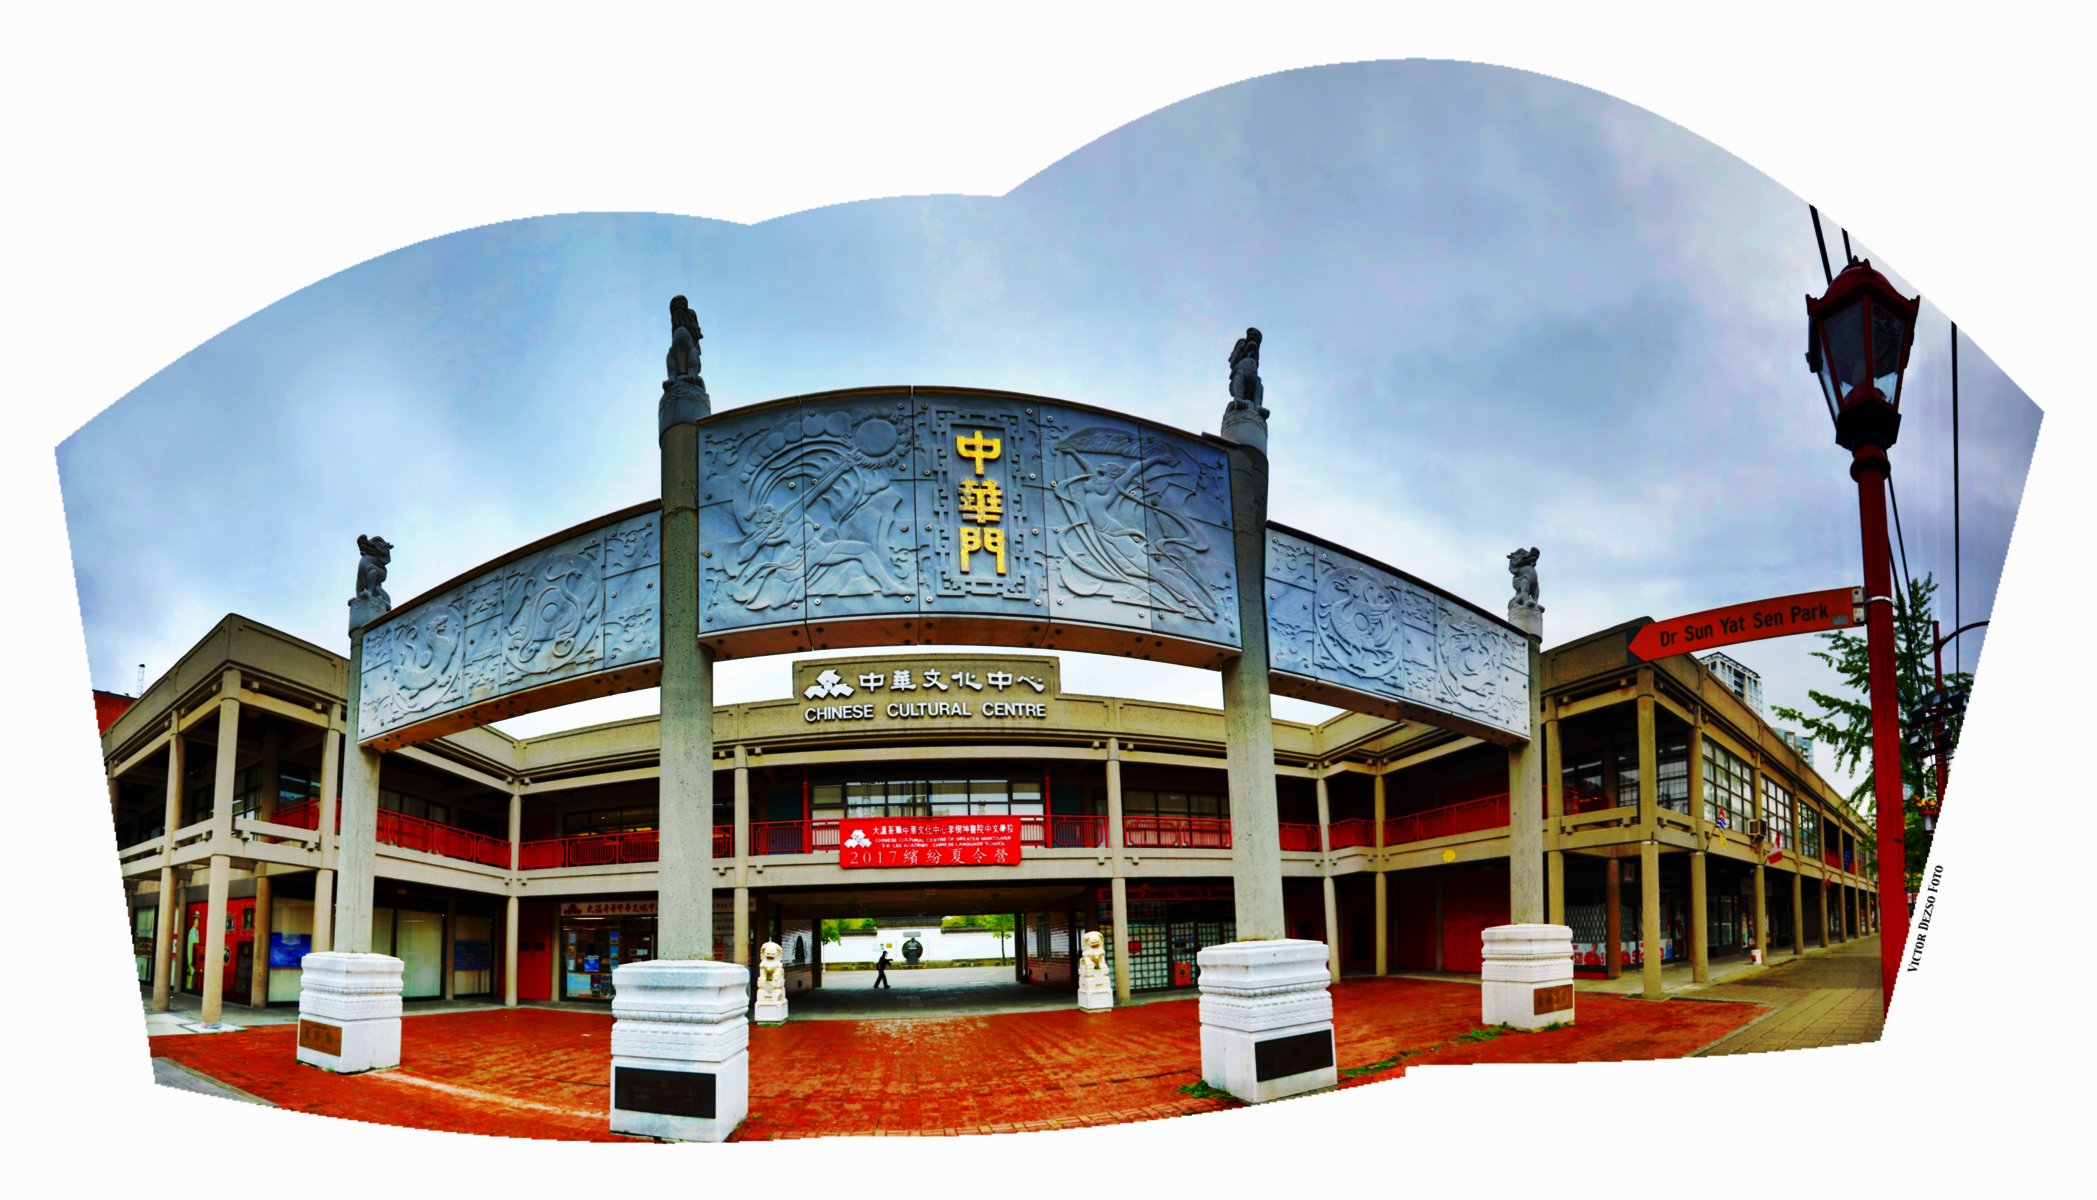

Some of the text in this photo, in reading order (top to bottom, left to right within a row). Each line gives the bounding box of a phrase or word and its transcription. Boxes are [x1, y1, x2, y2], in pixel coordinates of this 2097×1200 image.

[956, 430, 1006, 576] 中華門
[1660, 631, 1677, 647] Dr
[1685, 624, 1713, 641] Sun
[1719, 616, 1745, 635] Yat
[1752, 611, 1783, 629] Sen
[1791, 603, 1828, 624] Park
[858, 668, 1046, 693] 中華文化中心
[804, 702, 1046, 722] CHINESE CULTURAL CENTRE
